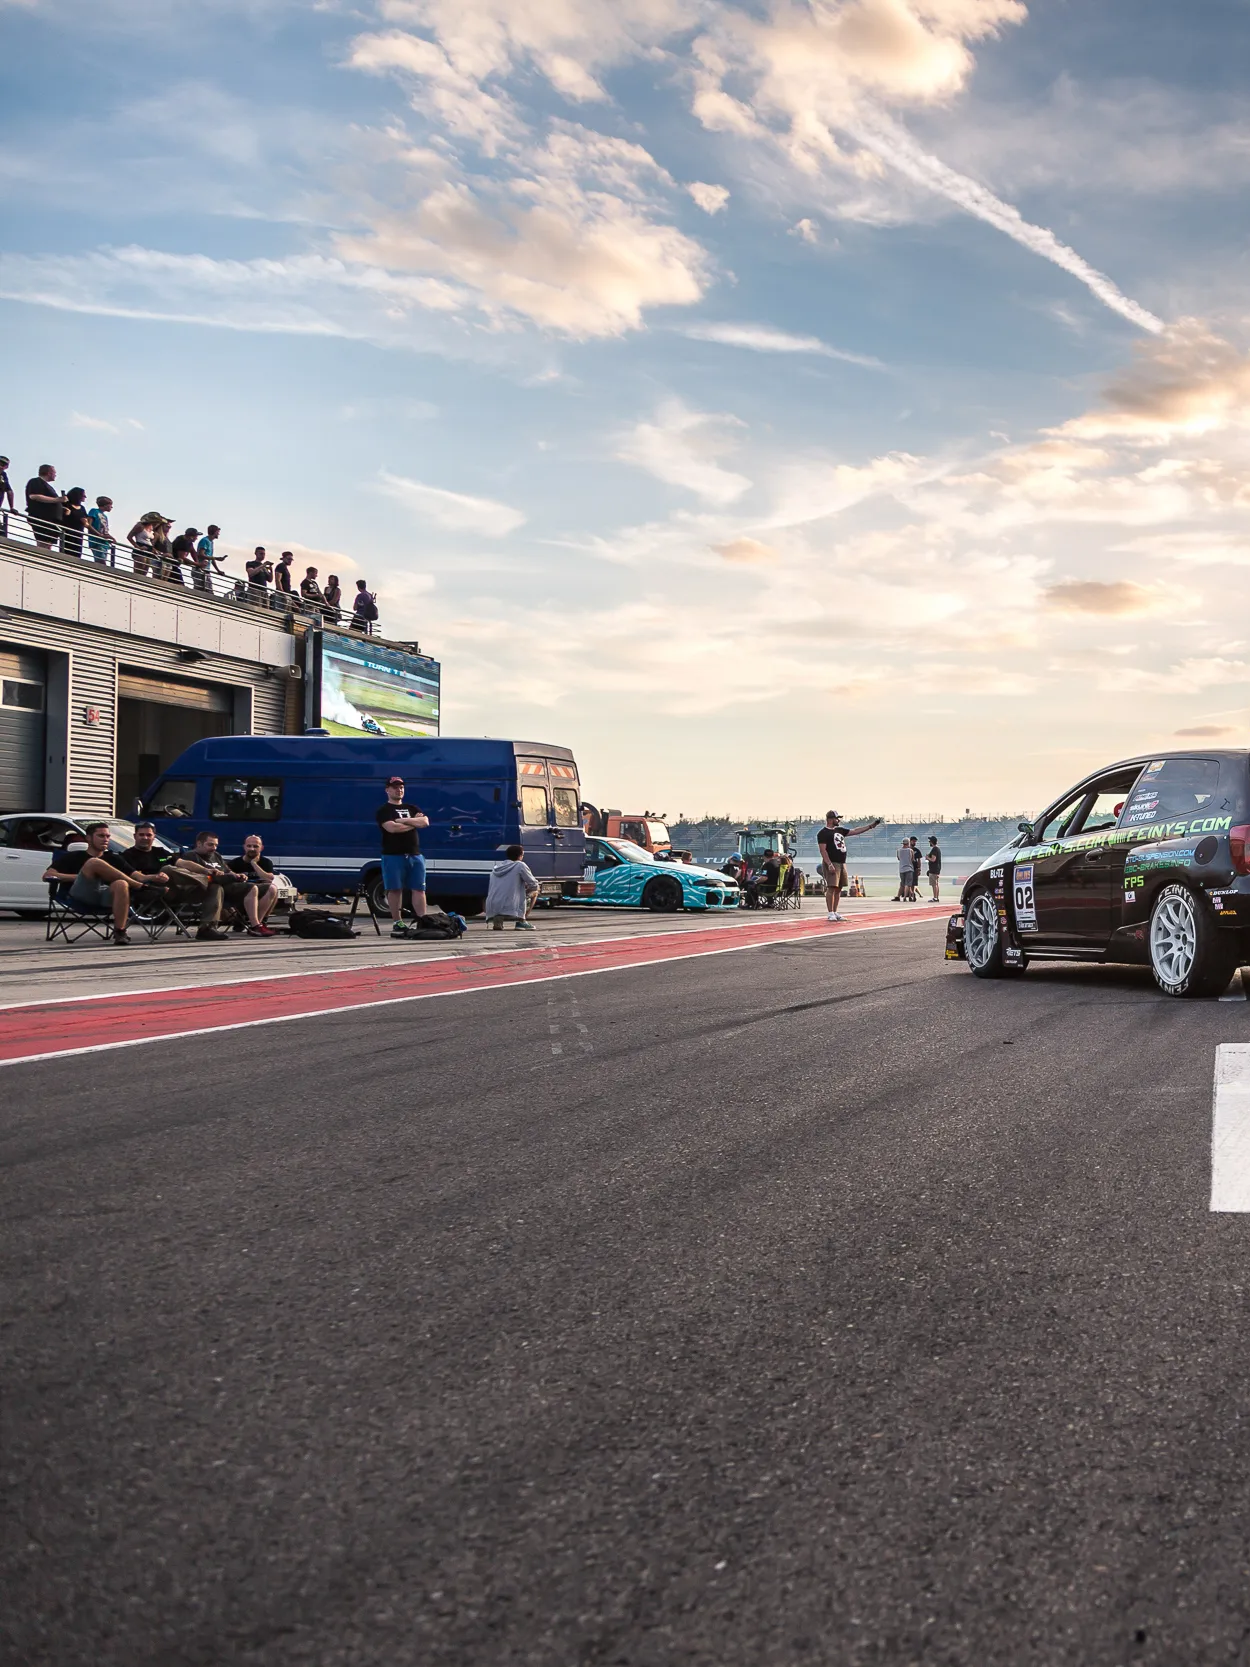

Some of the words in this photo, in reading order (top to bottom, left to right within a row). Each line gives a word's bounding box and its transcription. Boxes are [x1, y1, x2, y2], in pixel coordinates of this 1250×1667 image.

[367, 661, 391, 674] TURN
[88, 708, 100, 722] 54
[1126, 816, 1233, 843] FEINYS.COM
[1028, 834, 1105, 861] FEINYS.COM
[1124, 875, 1144, 889] FPS
[1015, 886, 1034, 910] 02
